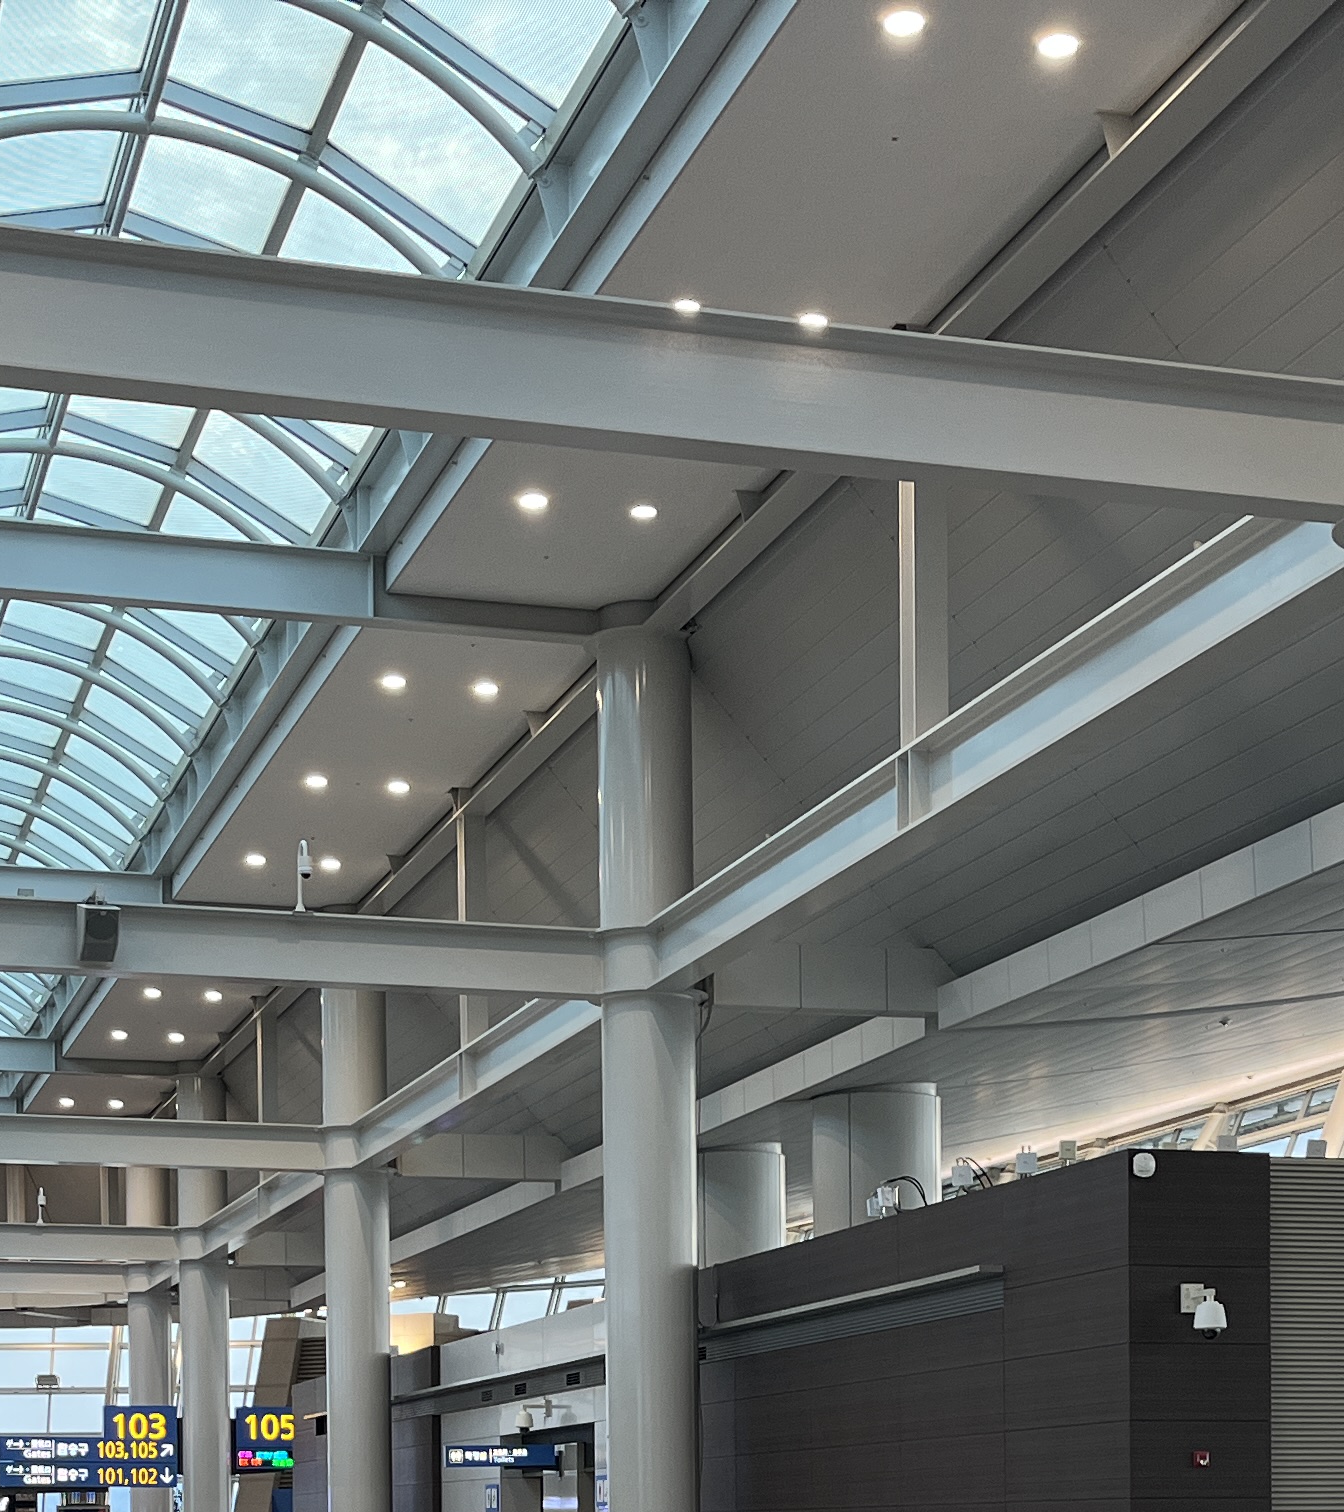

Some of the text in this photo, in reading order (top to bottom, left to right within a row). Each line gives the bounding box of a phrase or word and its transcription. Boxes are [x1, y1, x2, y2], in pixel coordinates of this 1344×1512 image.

[112, 1412, 167, 1440] 103
[244, 1413, 295, 1441] 105
[22, 1449, 52, 1459] Gates
[96, 1440, 158, 1460] 103,105
[22, 1475, 52, 1485] Gates
[97, 1467, 158, 1486] 101,102
